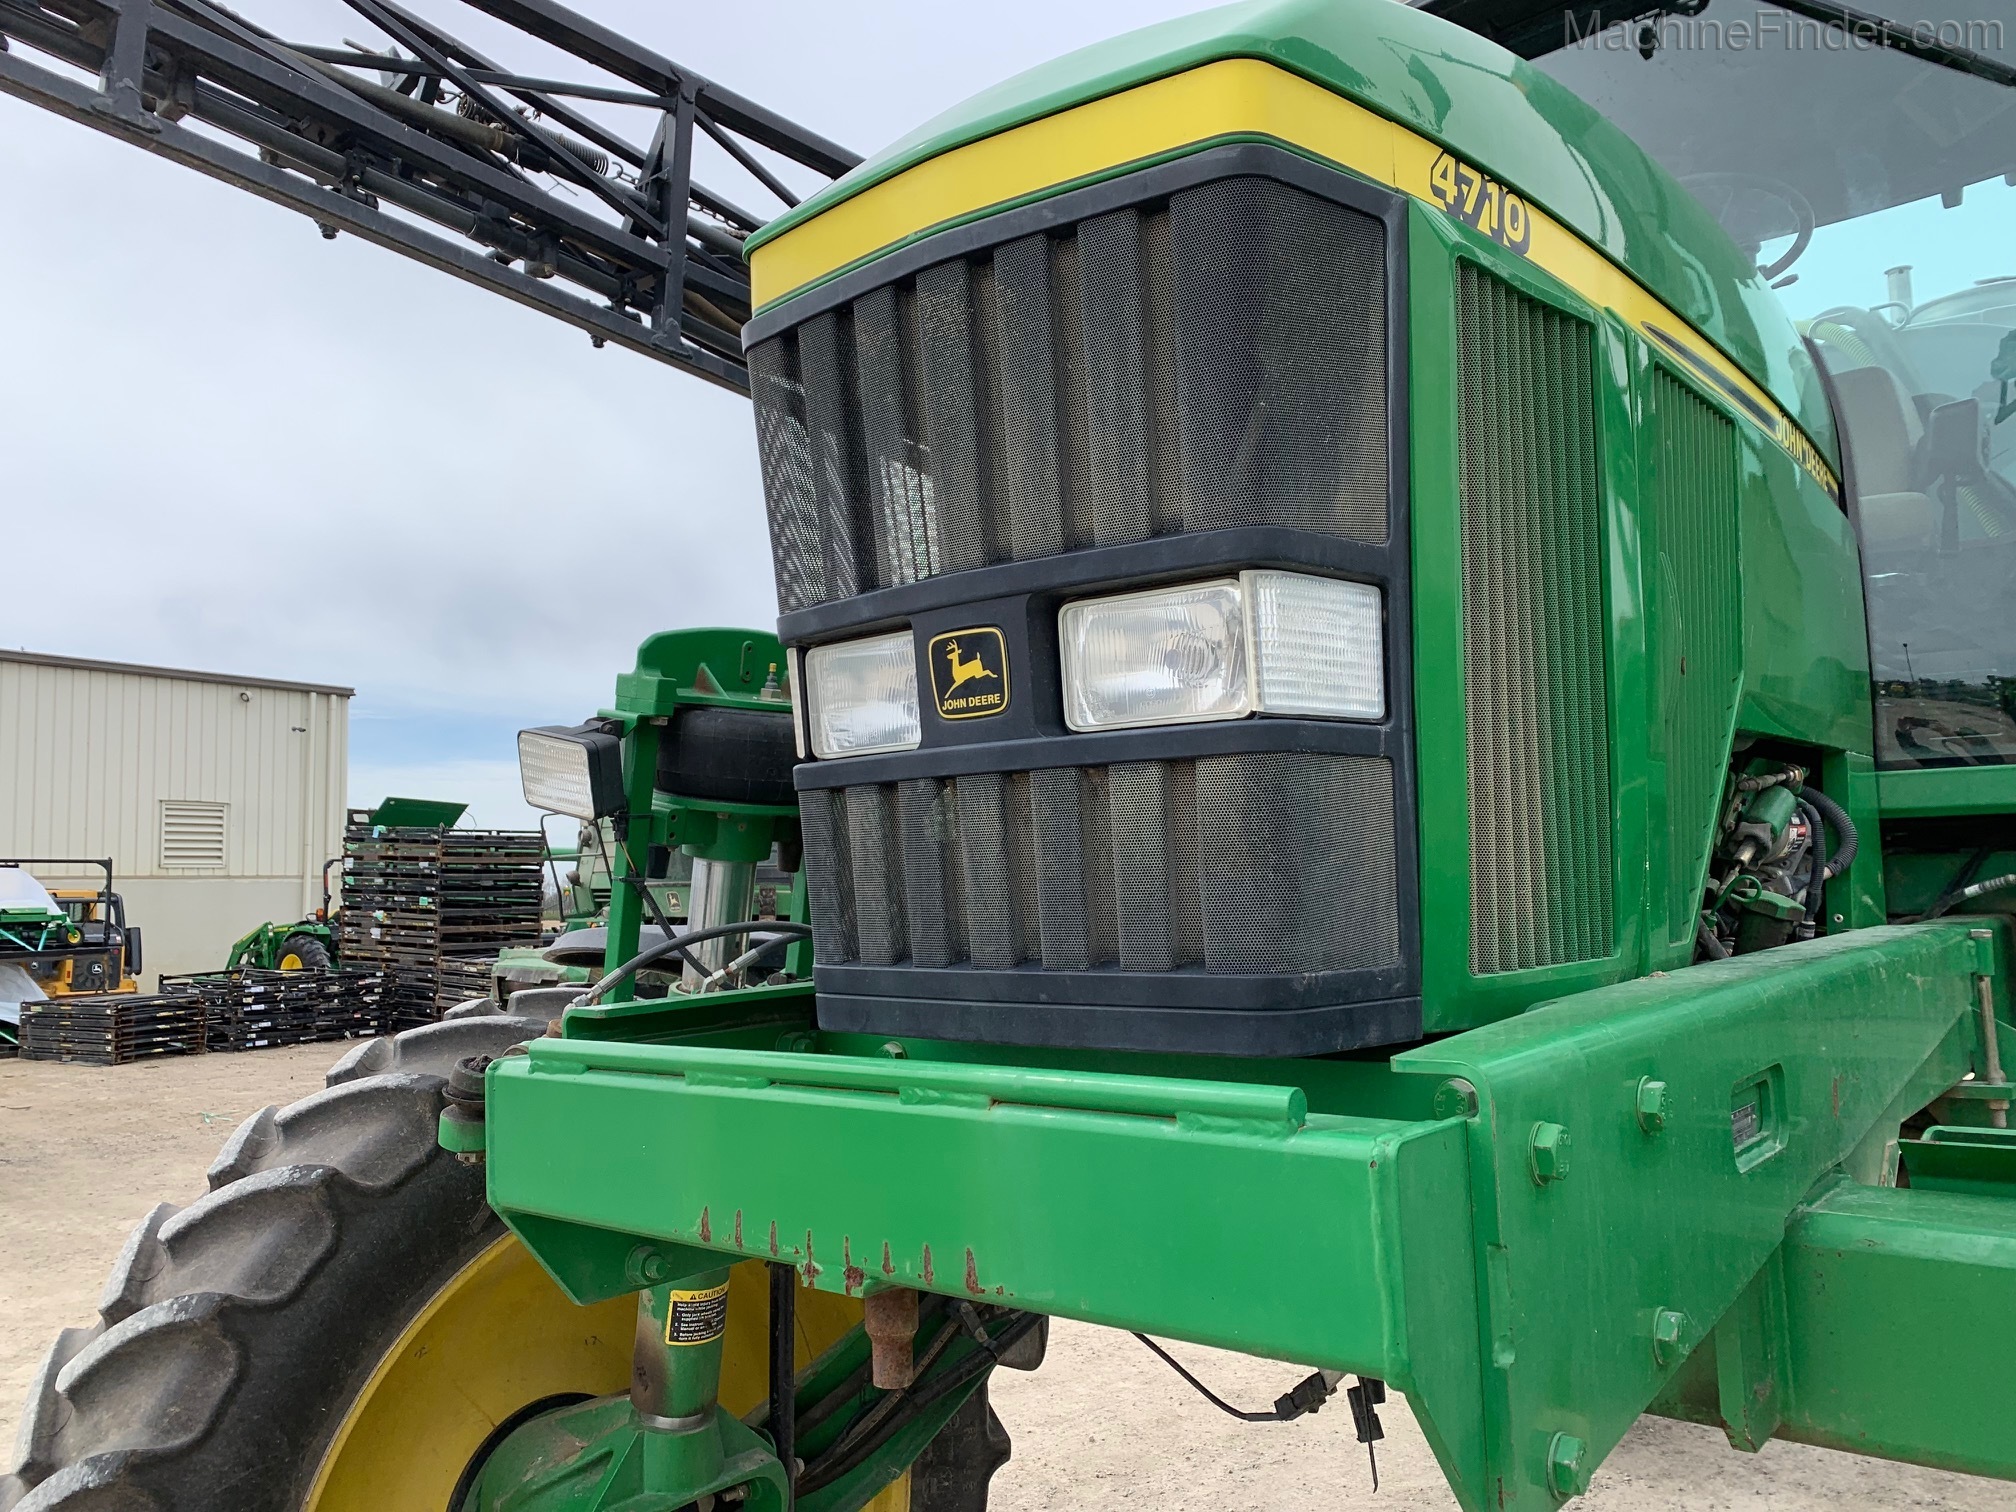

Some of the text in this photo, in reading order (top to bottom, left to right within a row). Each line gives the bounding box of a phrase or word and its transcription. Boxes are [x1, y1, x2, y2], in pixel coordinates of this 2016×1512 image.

[1430, 150, 1528, 251] 4710
[1775, 411, 1803, 463] JOHN
[942, 693, 1001, 711] JOHN DEERE
[697, 1286, 726, 1300] CAUTION
